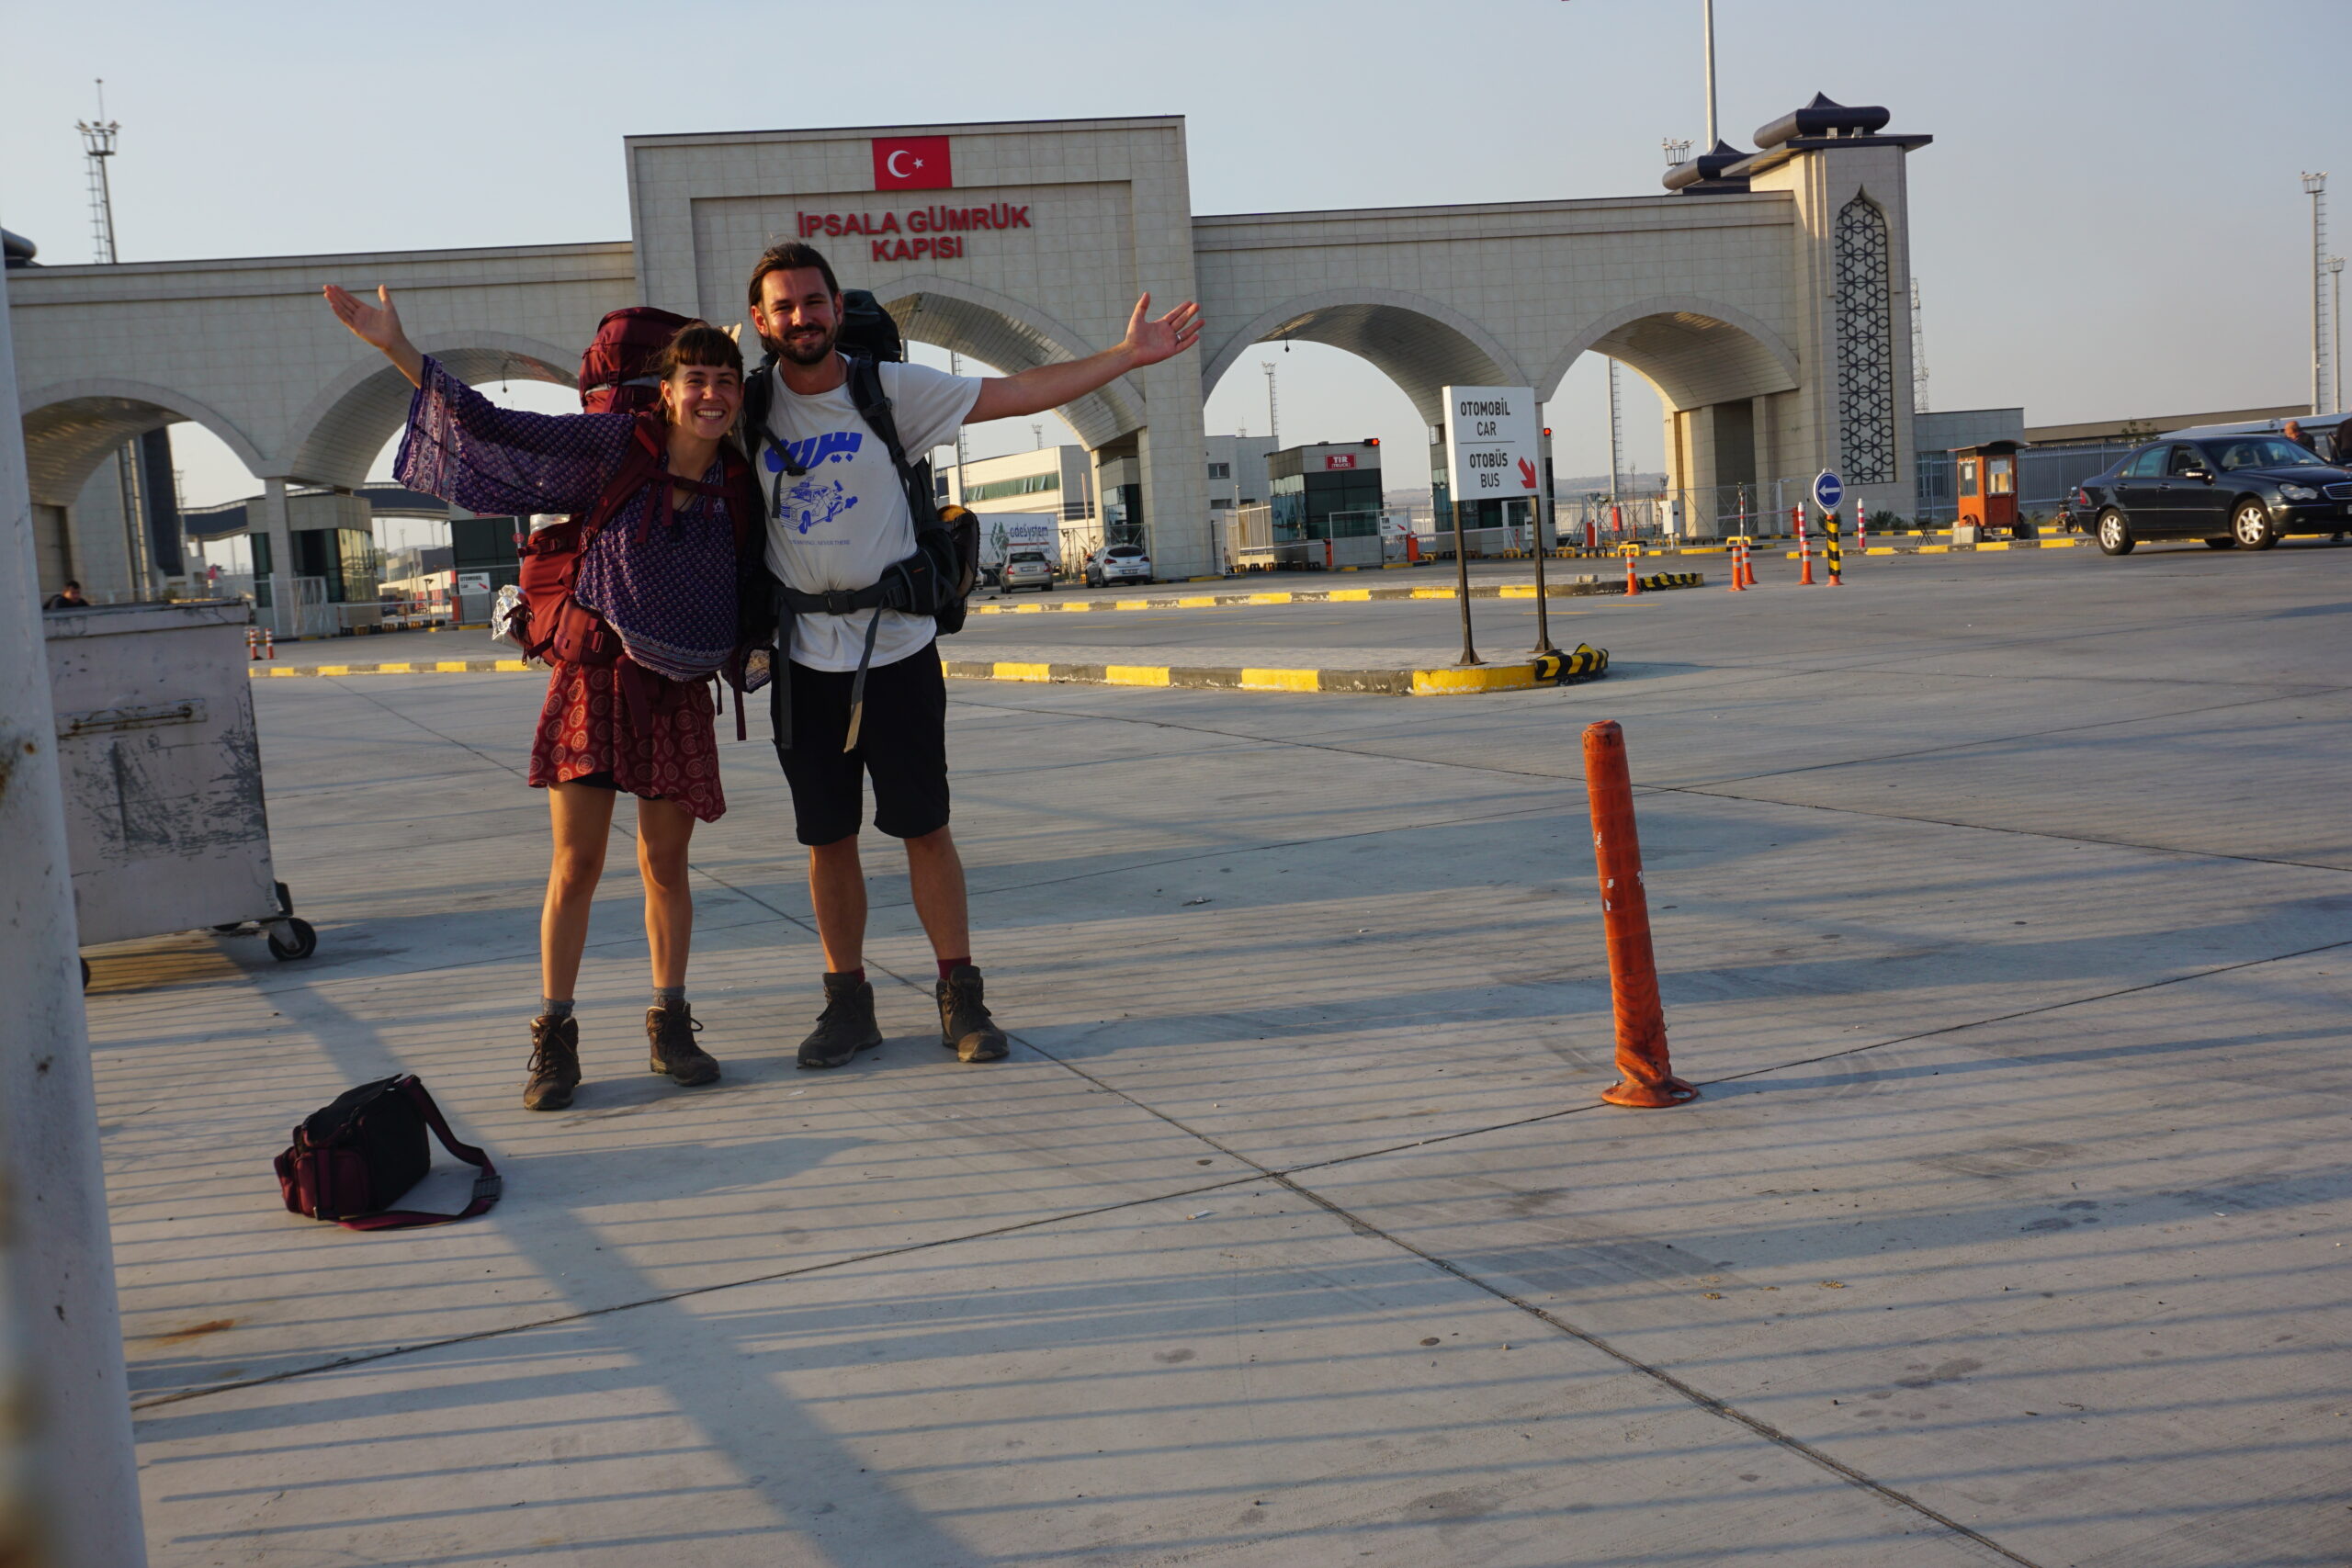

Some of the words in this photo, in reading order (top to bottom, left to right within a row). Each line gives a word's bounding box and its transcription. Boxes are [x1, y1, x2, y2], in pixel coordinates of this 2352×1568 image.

[797, 211, 899, 237] İPSALA
[907, 203, 1031, 232] GÜMRÜK
[872, 235, 963, 262] KAPISI
[1460, 398, 1510, 416] OTOMOBİL
[1476, 422, 1497, 436] CAR
[1333, 456, 1348, 464] TIR
[1469, 448, 1508, 468] OTOBÜS
[1480, 473, 1500, 488] BUS
